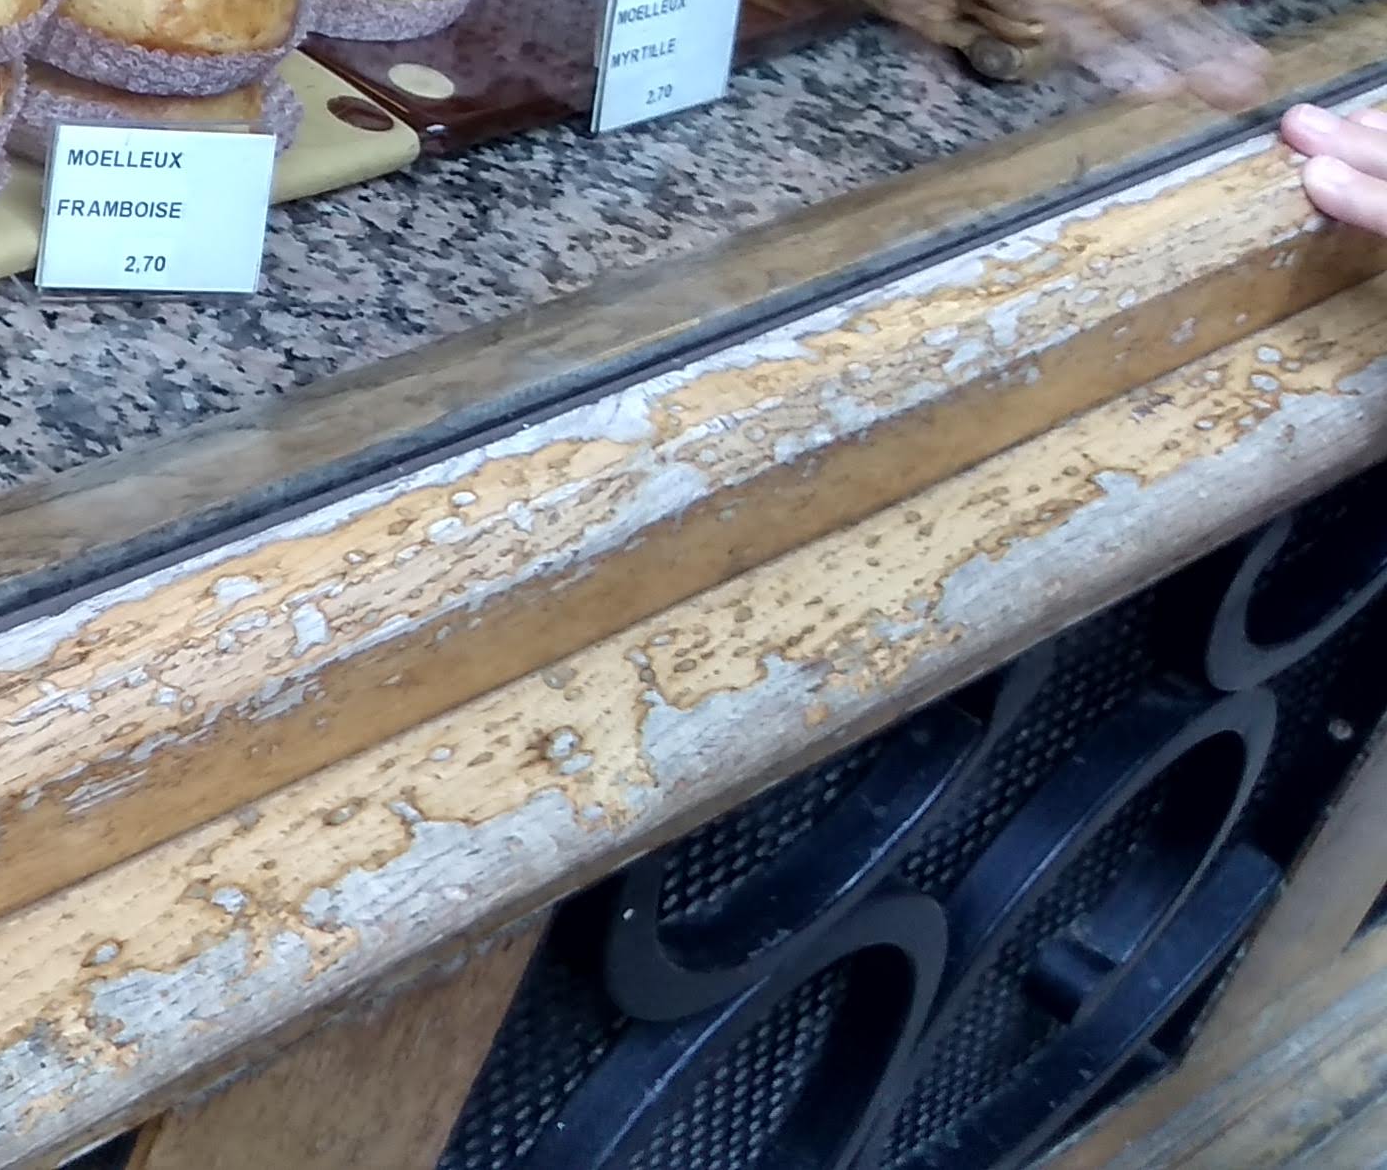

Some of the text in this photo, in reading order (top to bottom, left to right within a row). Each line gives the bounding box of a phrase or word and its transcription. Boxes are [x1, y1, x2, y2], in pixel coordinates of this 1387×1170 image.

[610, 38, 676, 68] MYRTILLE
[67, 149, 183, 169] MOELLEUX
[57, 199, 183, 219] FRAMBOISE
[124, 256, 166, 274] 2,70
